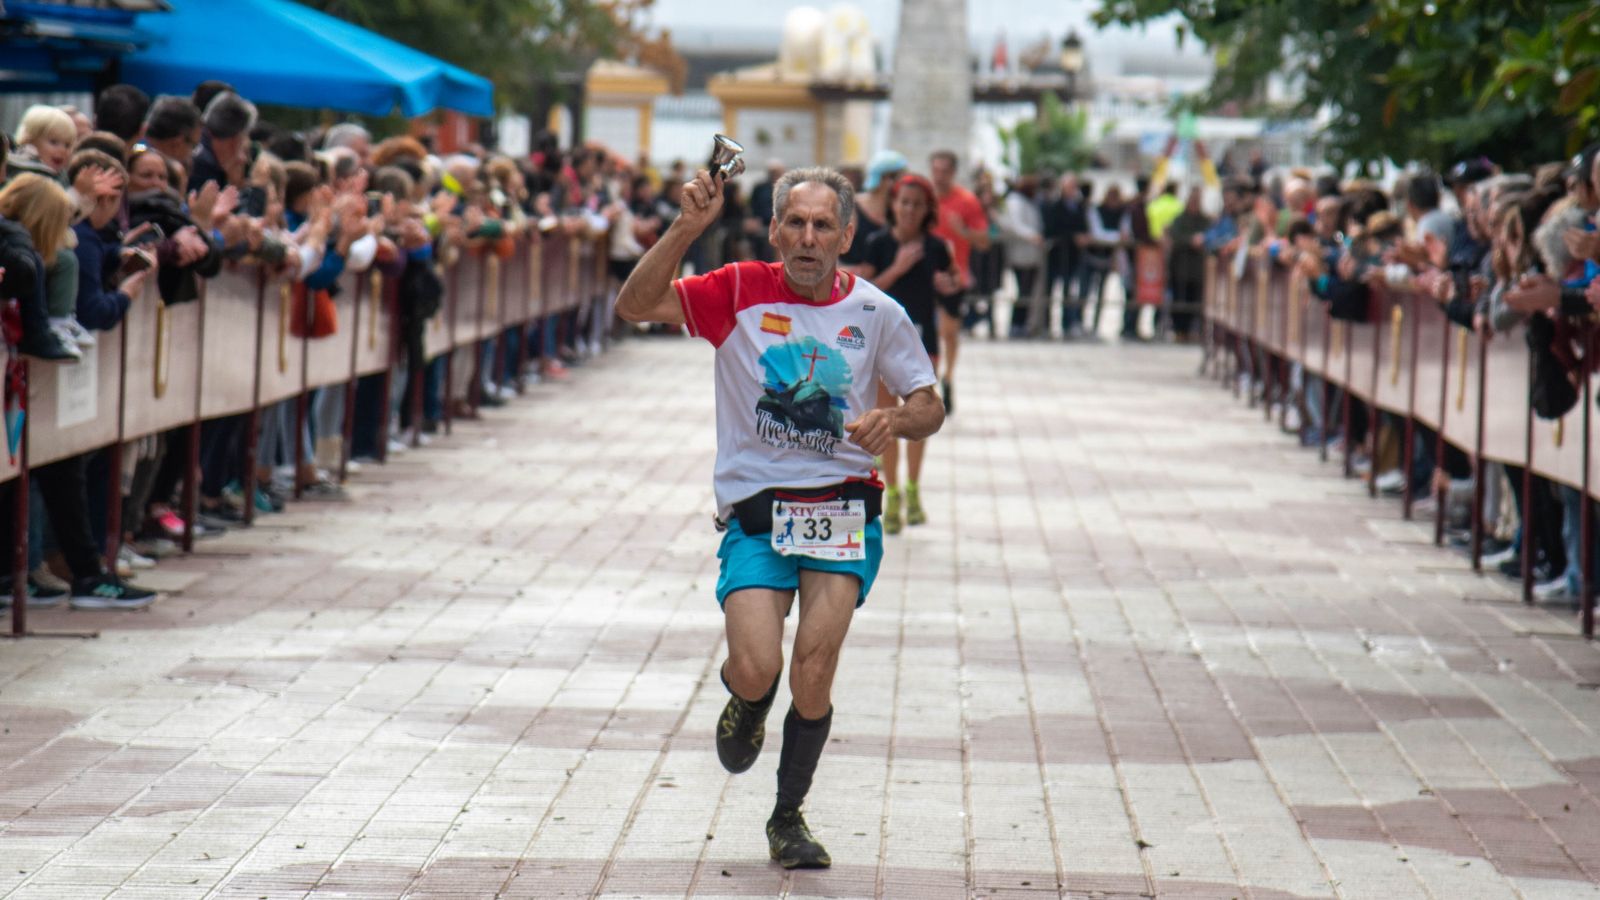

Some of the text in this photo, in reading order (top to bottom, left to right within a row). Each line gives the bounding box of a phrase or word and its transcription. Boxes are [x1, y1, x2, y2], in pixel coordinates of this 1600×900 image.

[756, 408, 785, 440] Vive
[786, 419, 801, 442] la
[804, 428, 837, 456] vida
[788, 506, 816, 517] XIV
[803, 517, 832, 541] 33
